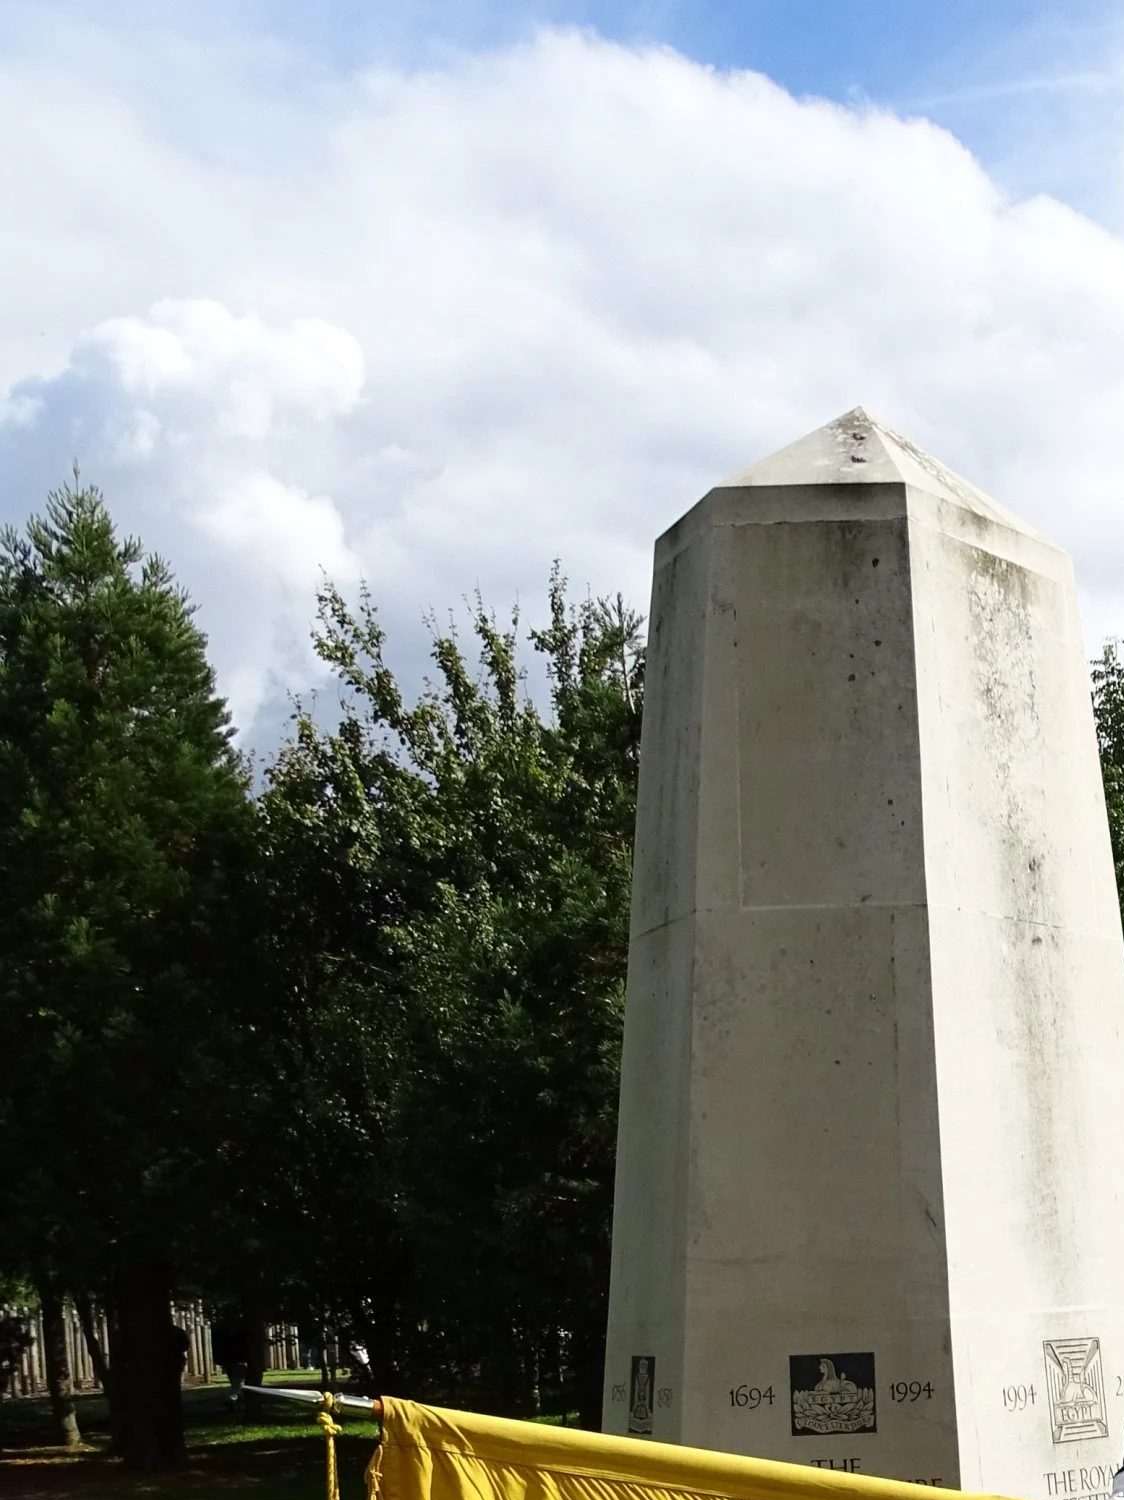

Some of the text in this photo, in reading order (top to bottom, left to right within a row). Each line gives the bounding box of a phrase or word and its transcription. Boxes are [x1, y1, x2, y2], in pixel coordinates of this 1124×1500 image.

[729, 1381, 935, 1410] 1694 1994
[1002, 1384, 1037, 1412] 1994
[1060, 1405, 1094, 1422] EGYPT
[1043, 1463, 1121, 1496] THE ROYA
